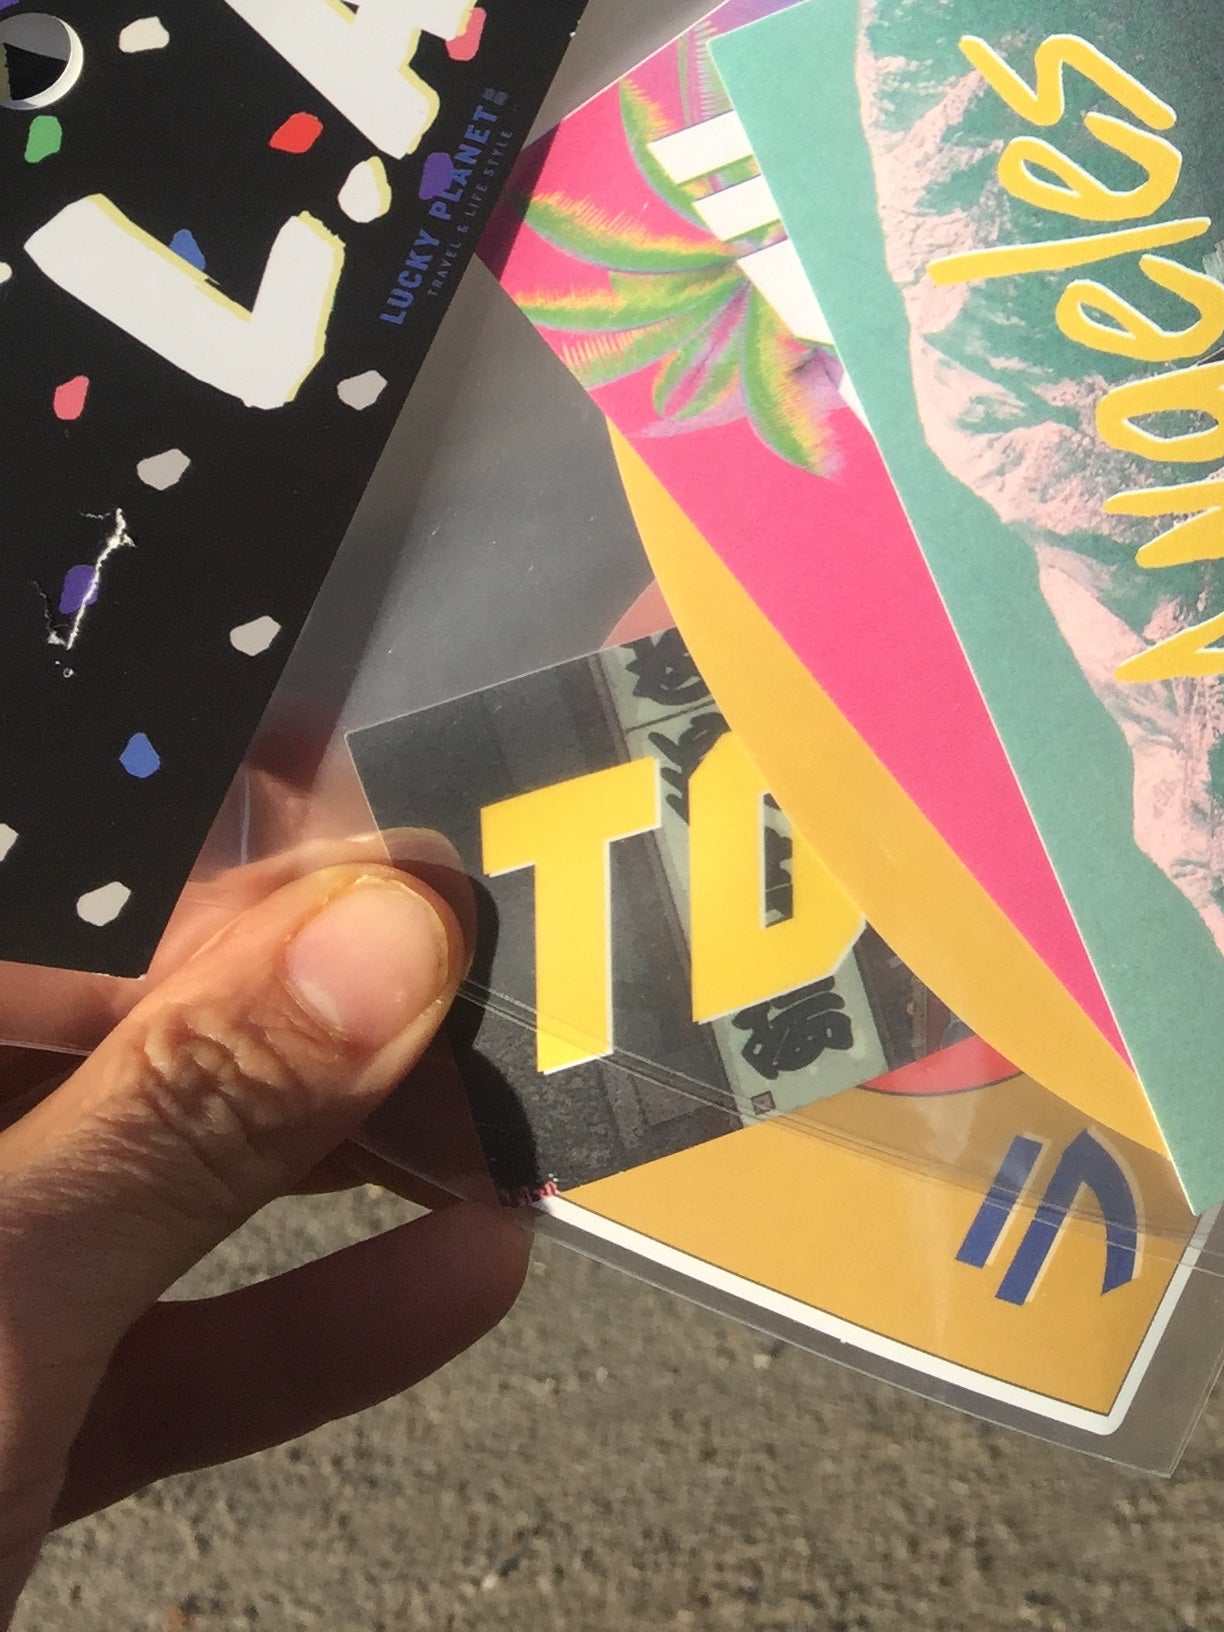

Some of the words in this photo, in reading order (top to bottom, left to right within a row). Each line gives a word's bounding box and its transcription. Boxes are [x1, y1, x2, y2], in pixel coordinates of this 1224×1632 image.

[379, 229, 441, 326] LUCKY
[428, 104, 499, 222] PLANET
[427, 241, 462, 298] TRAVEL
[456, 223, 470, 234] &
[465, 183, 489, 218] LIFE
[483, 130, 513, 178] STYLE
